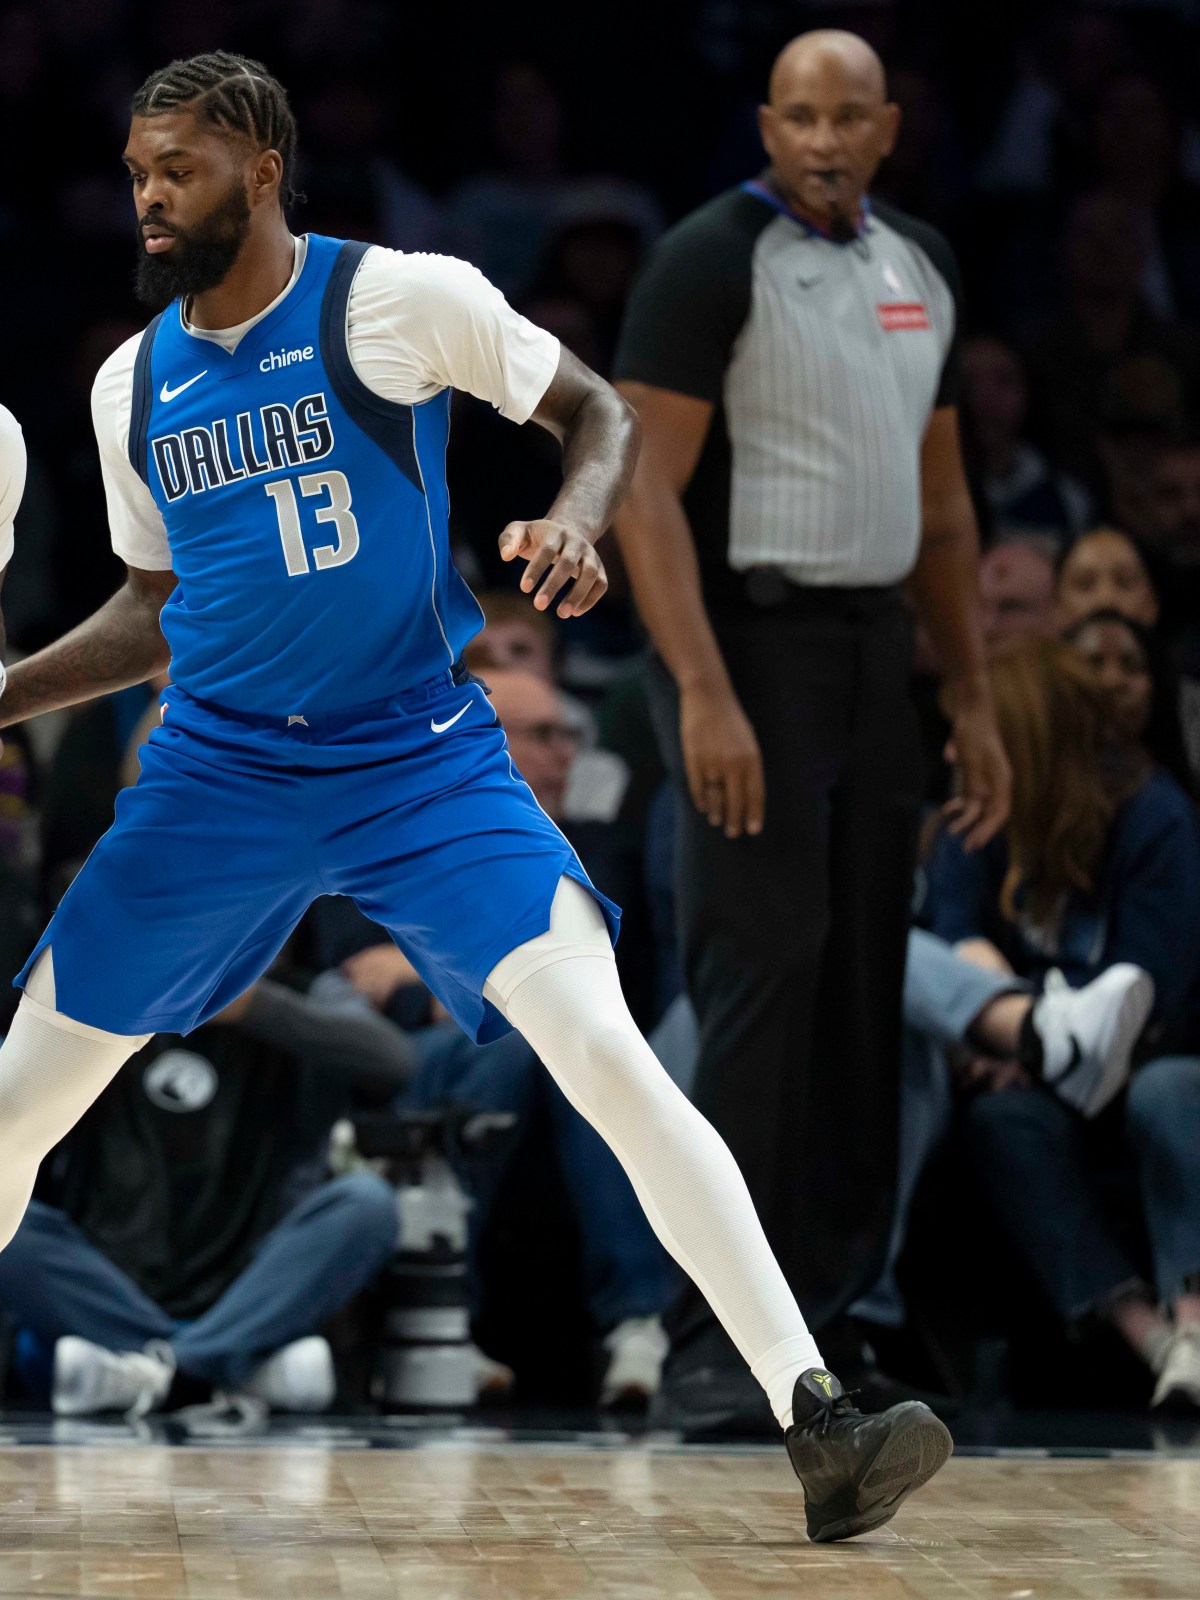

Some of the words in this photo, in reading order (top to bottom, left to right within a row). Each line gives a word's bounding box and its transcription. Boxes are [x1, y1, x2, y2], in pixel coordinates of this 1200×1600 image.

[259, 346, 314, 373] chime
[151, 392, 334, 503] DALLAS
[264, 470, 360, 578] 13
